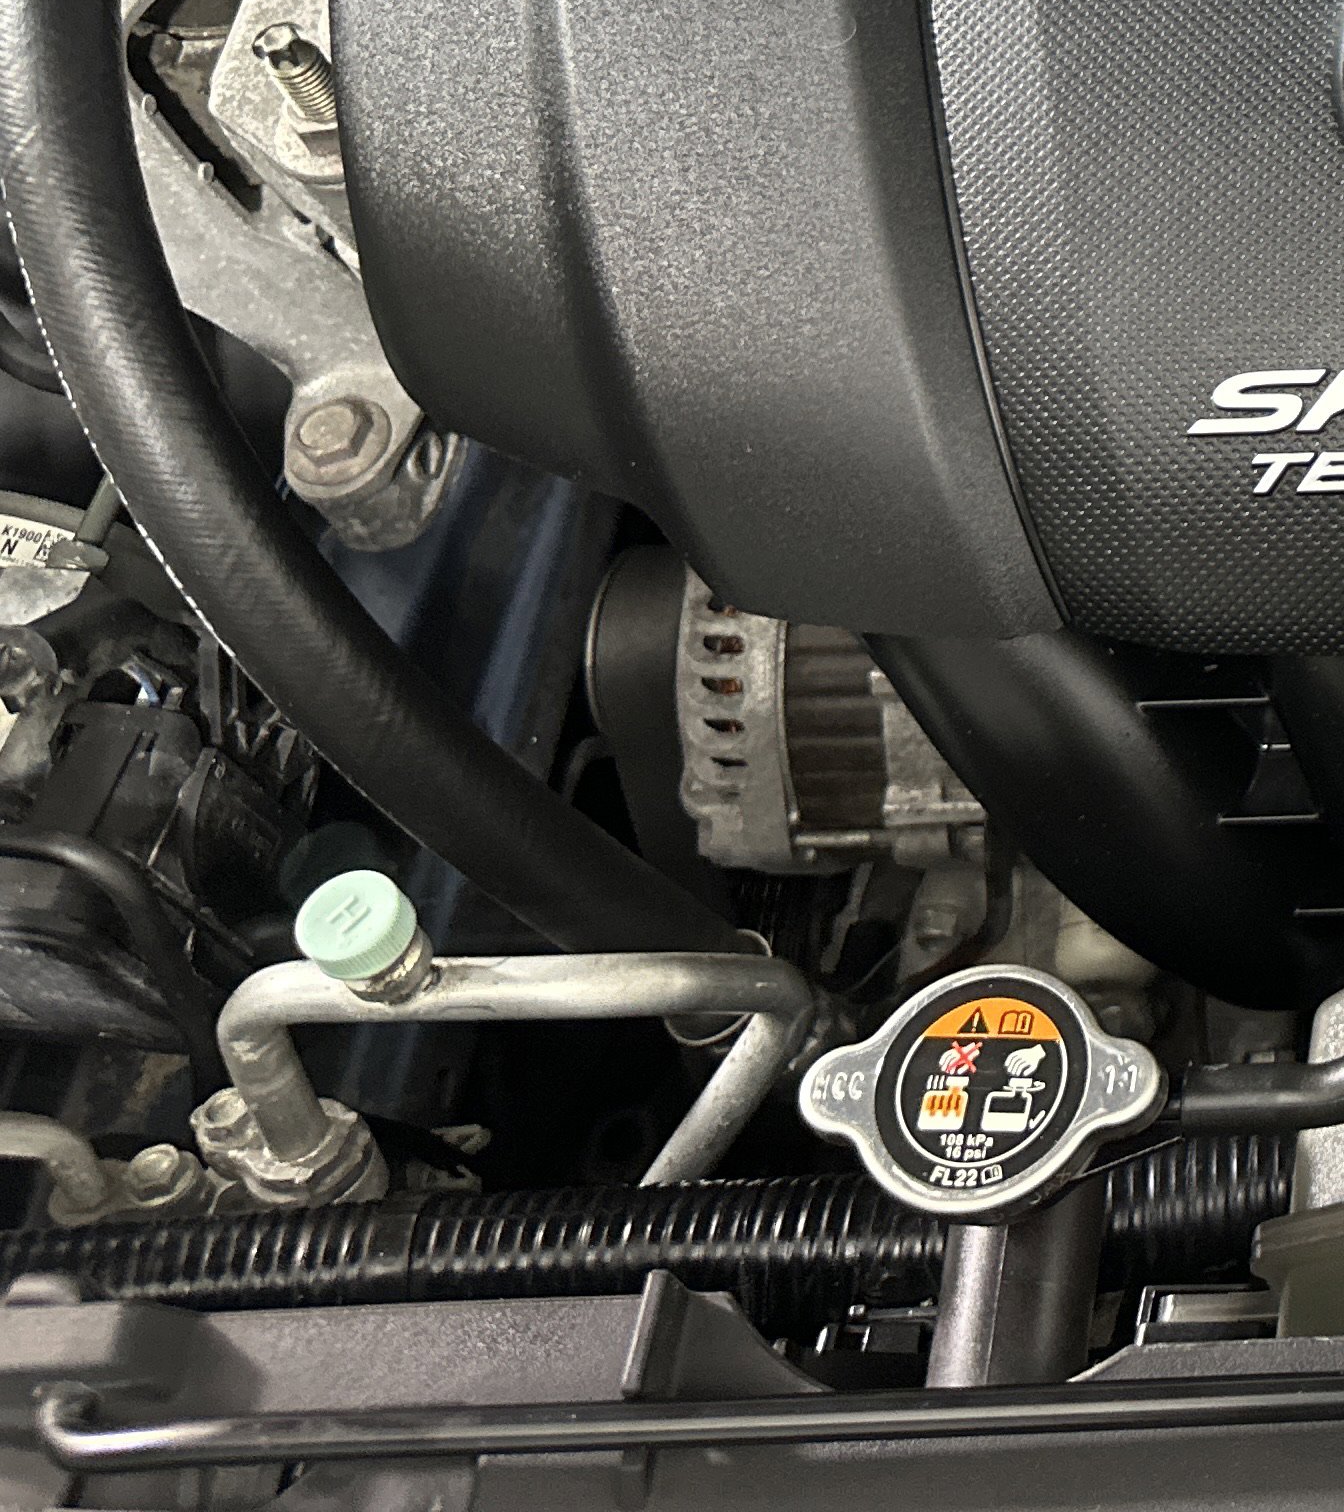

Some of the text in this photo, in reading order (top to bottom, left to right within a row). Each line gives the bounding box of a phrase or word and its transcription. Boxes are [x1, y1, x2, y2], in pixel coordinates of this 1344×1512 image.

[326, 895, 372, 935] H
[940, 1133, 994, 1147] 108 kPa
[945, 1146, 987, 1161] 16 psi
[929, 1164, 978, 1187] FL22
